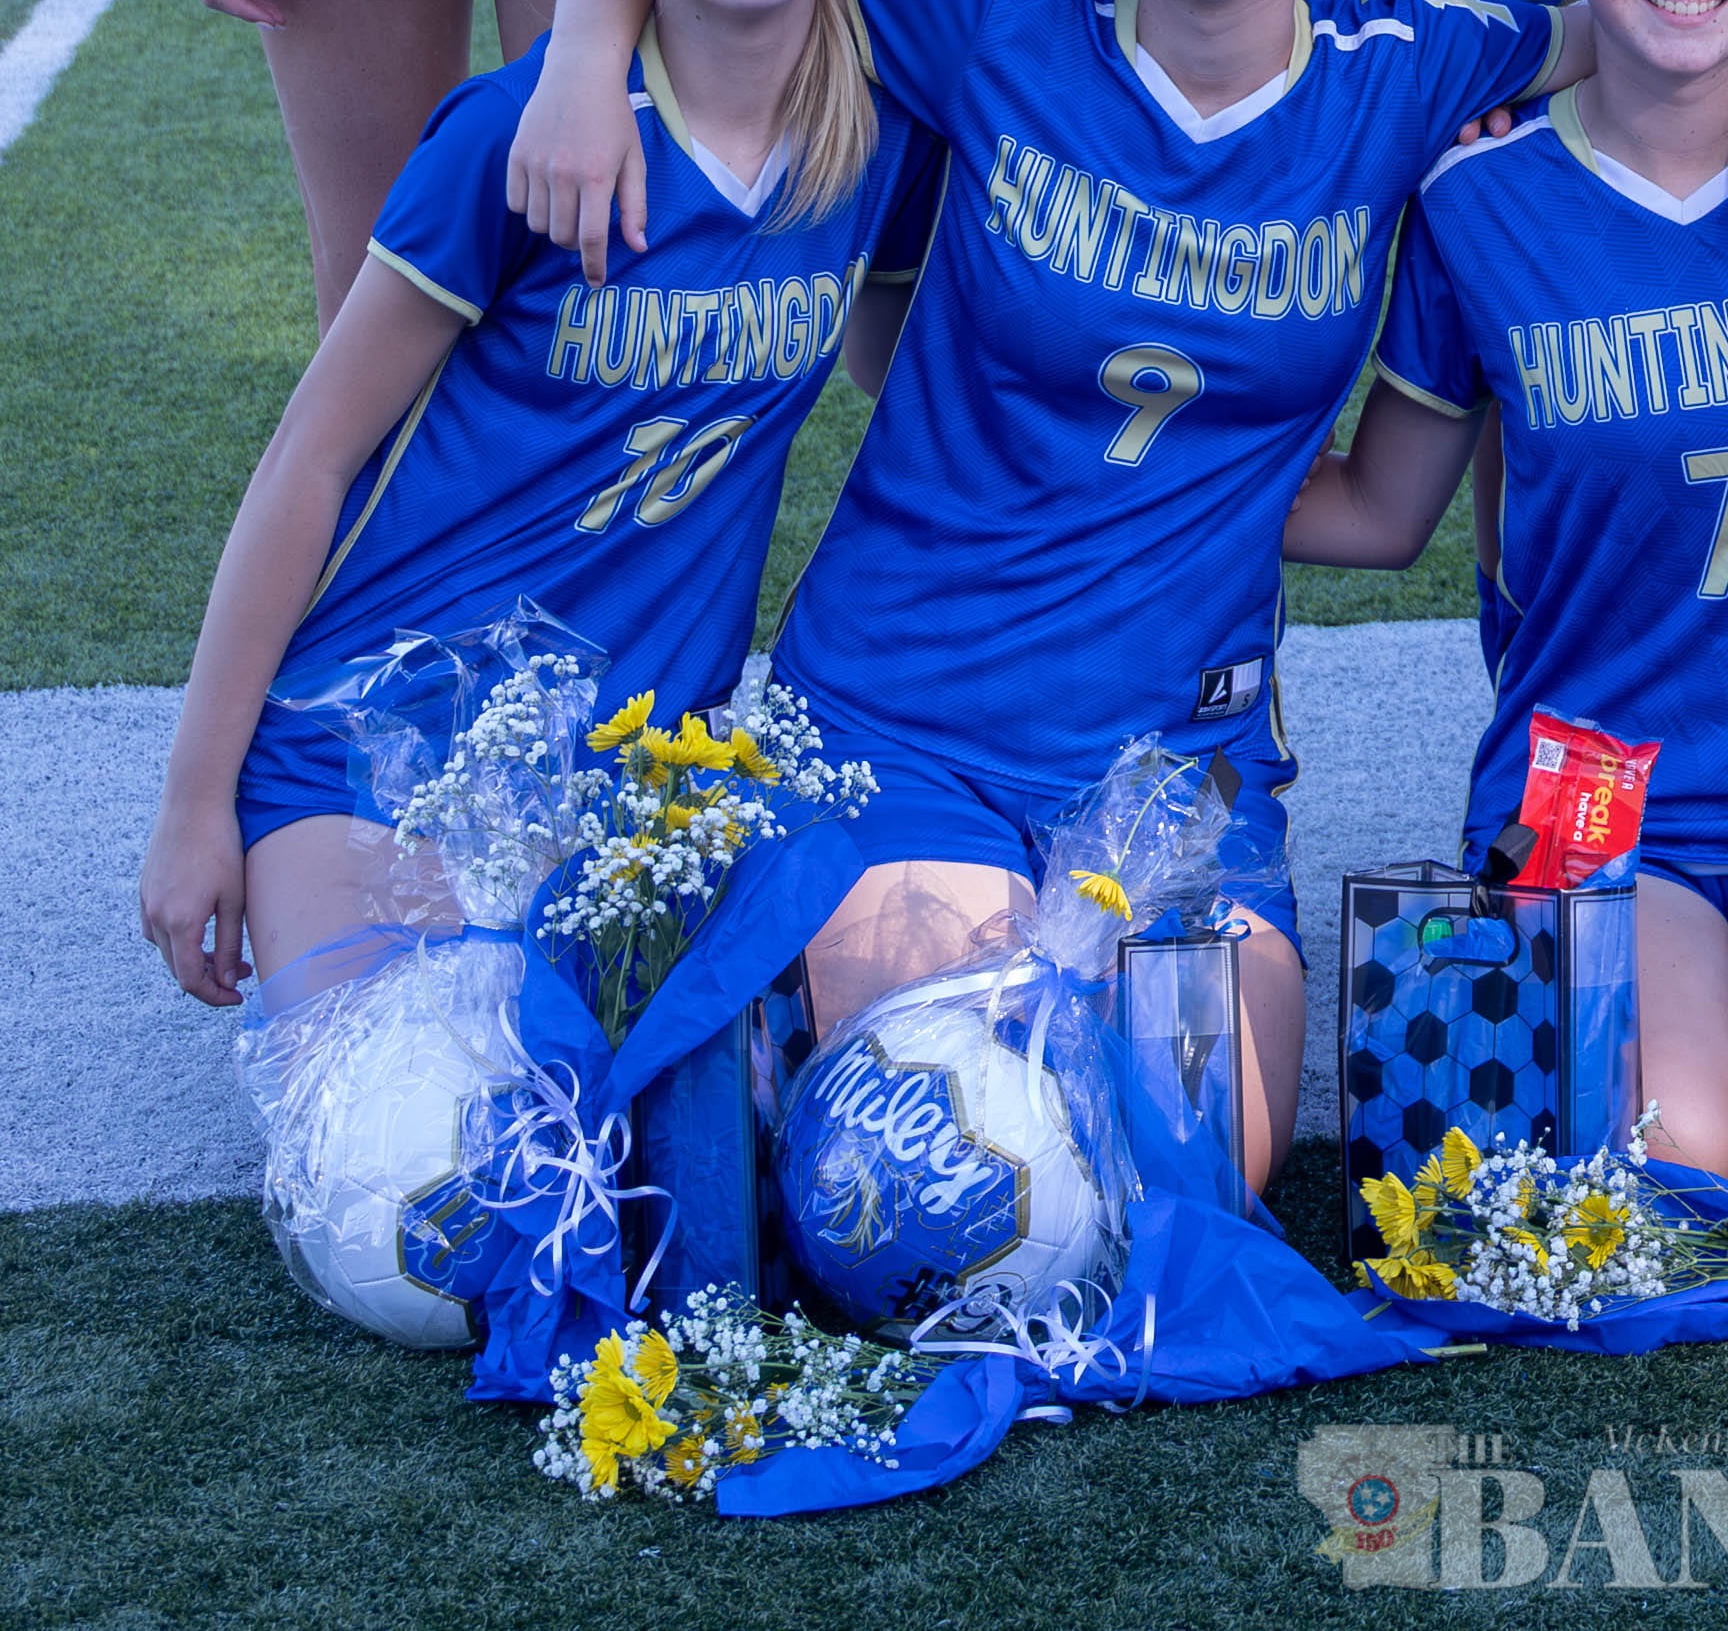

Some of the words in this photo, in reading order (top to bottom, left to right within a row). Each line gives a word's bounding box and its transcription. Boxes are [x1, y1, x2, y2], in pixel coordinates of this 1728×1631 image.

[986, 134, 1370, 322] HUNTINGDON
[1098, 342, 1205, 467] 9
[574, 416, 756, 534] 10
[1573, 831, 1584, 842] a
[1575, 791, 1593, 830] have
[1586, 753, 1624, 845] break
